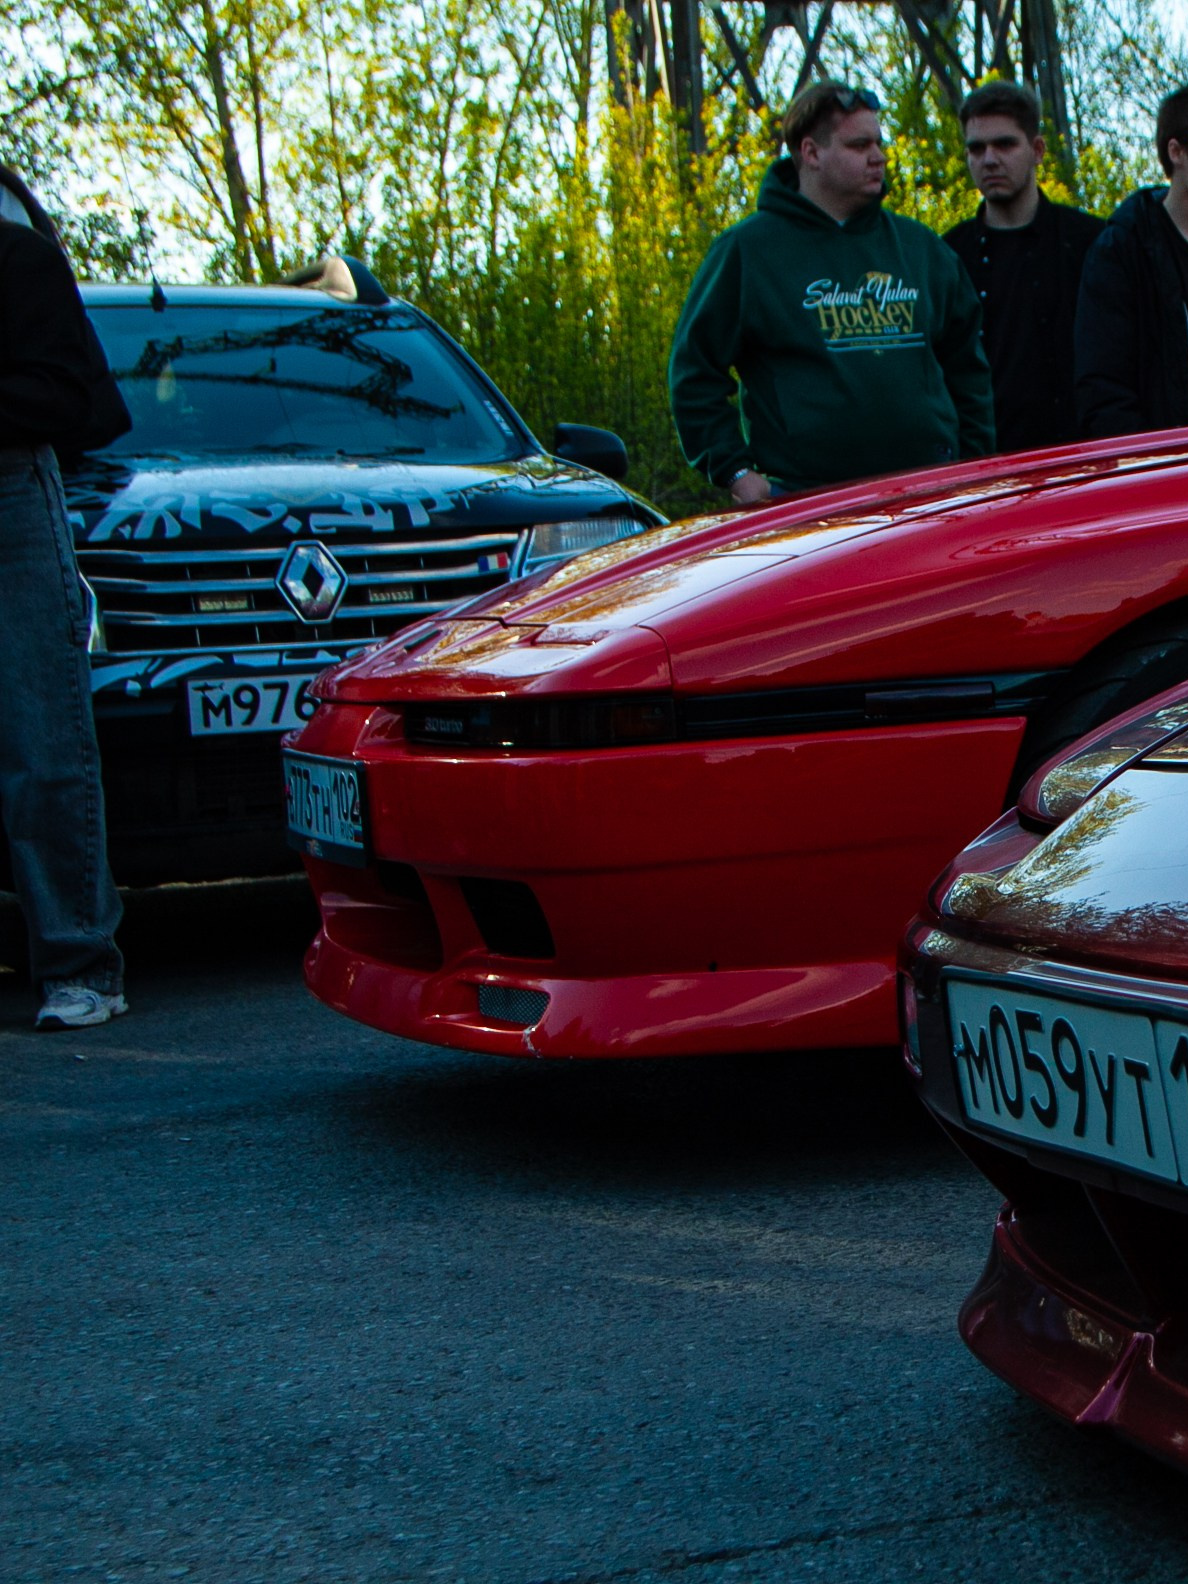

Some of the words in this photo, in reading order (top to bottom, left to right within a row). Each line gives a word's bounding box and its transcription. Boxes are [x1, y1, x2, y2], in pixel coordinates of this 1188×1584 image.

[816, 299, 915, 340] Hockey
[333, 771, 361, 823] 102
[960, 1004, 1155, 1159] М059УТ
